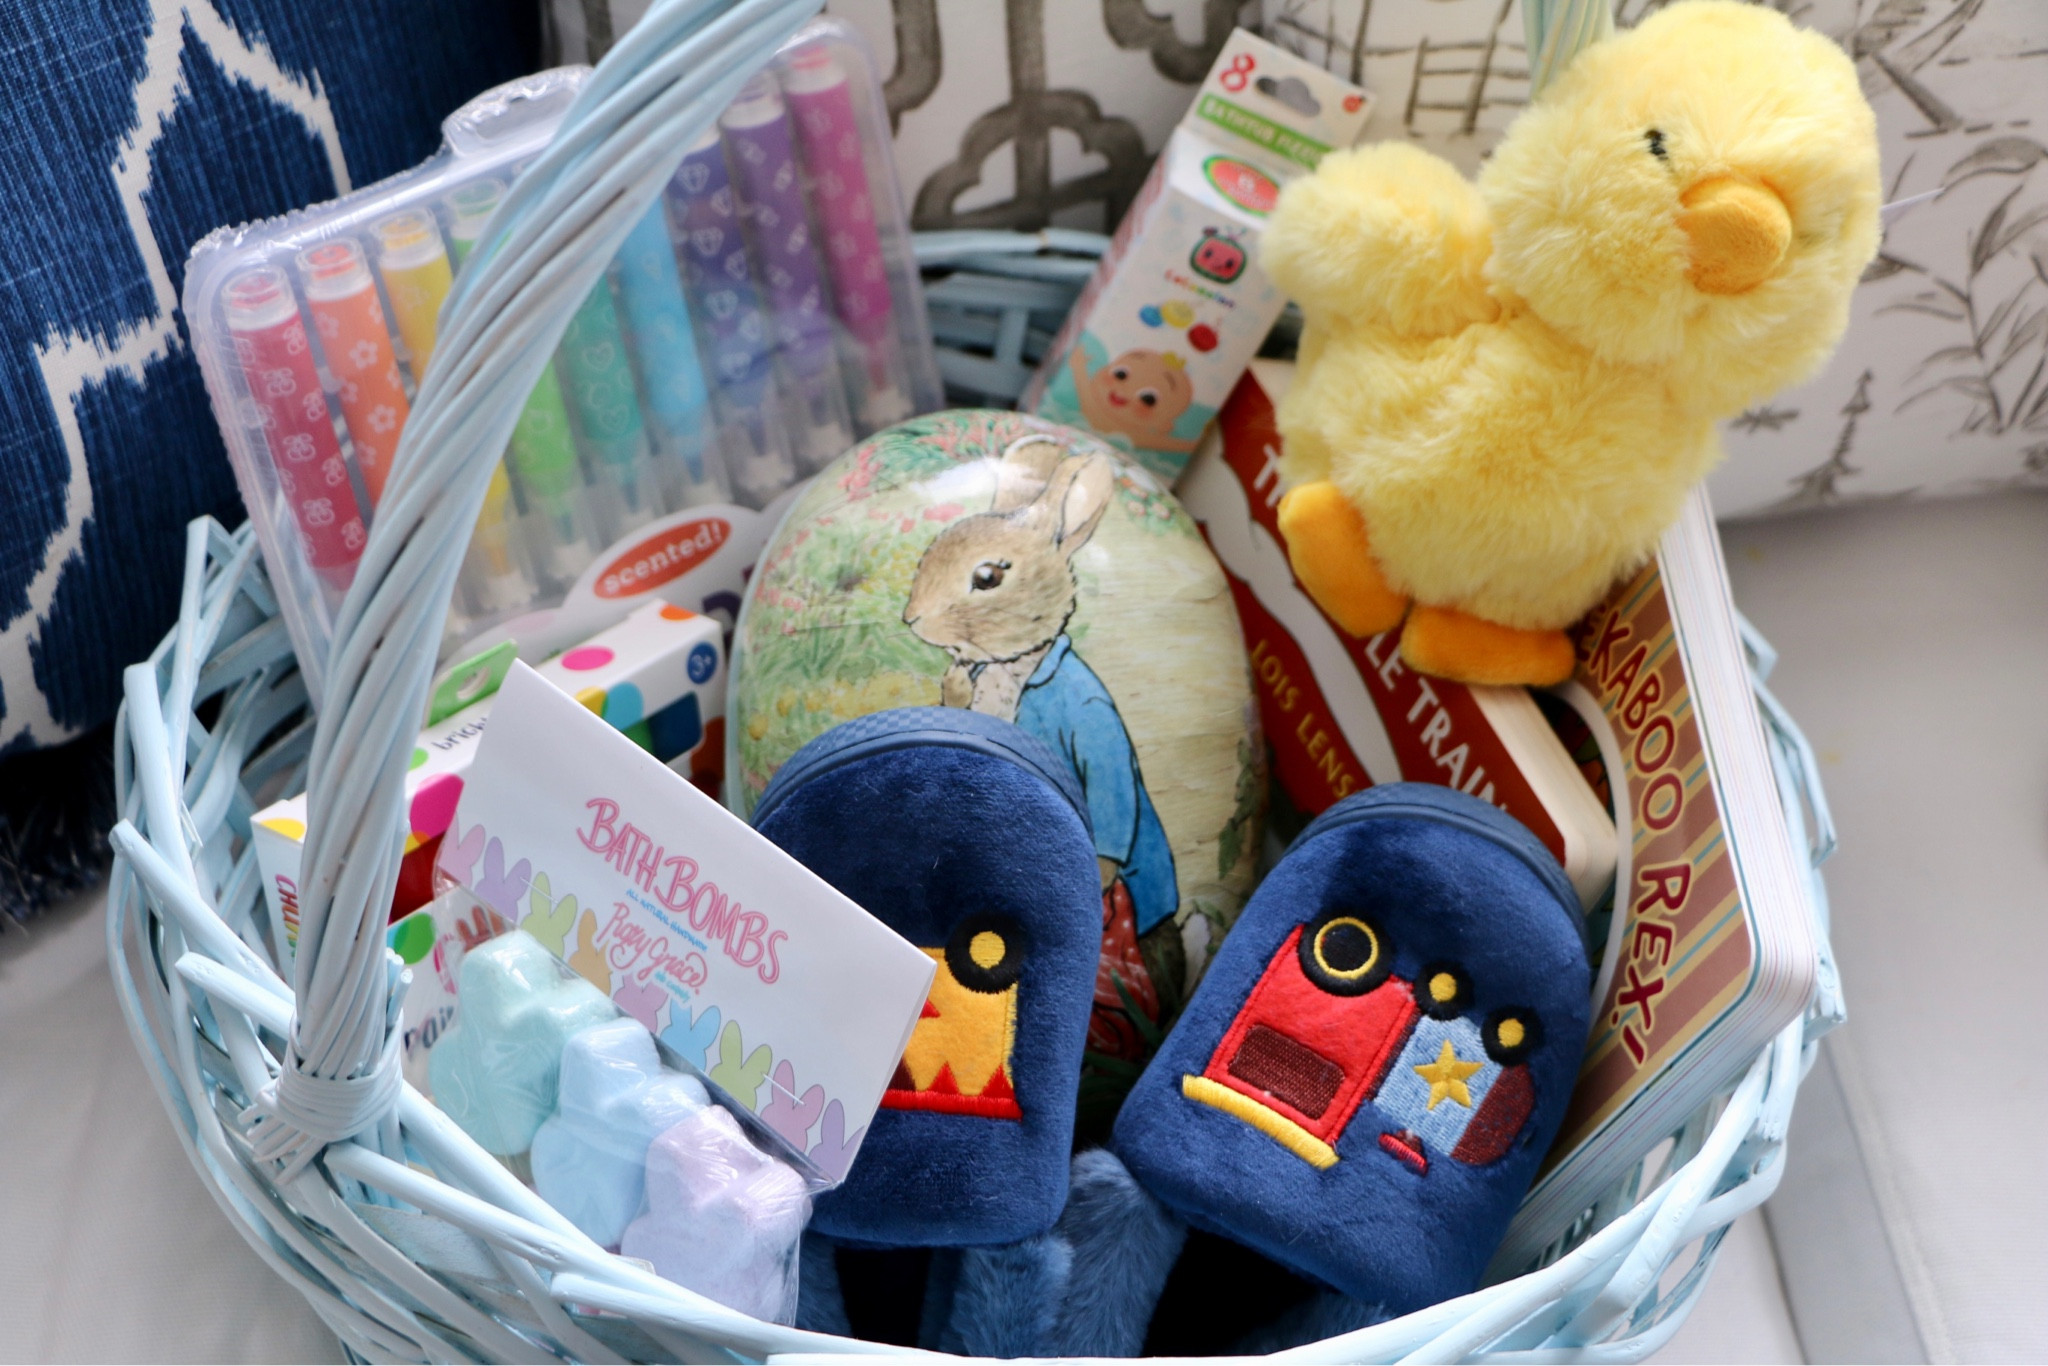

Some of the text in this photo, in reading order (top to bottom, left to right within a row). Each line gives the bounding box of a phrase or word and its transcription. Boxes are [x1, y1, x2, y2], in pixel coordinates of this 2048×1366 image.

[1219, 52, 1256, 93] 8
[603, 521, 722, 594] scented!
[1252, 639, 1300, 712] LOIS
[576, 797, 788, 984] BATH BOMBS
[1612, 862, 1691, 1065] REX!
